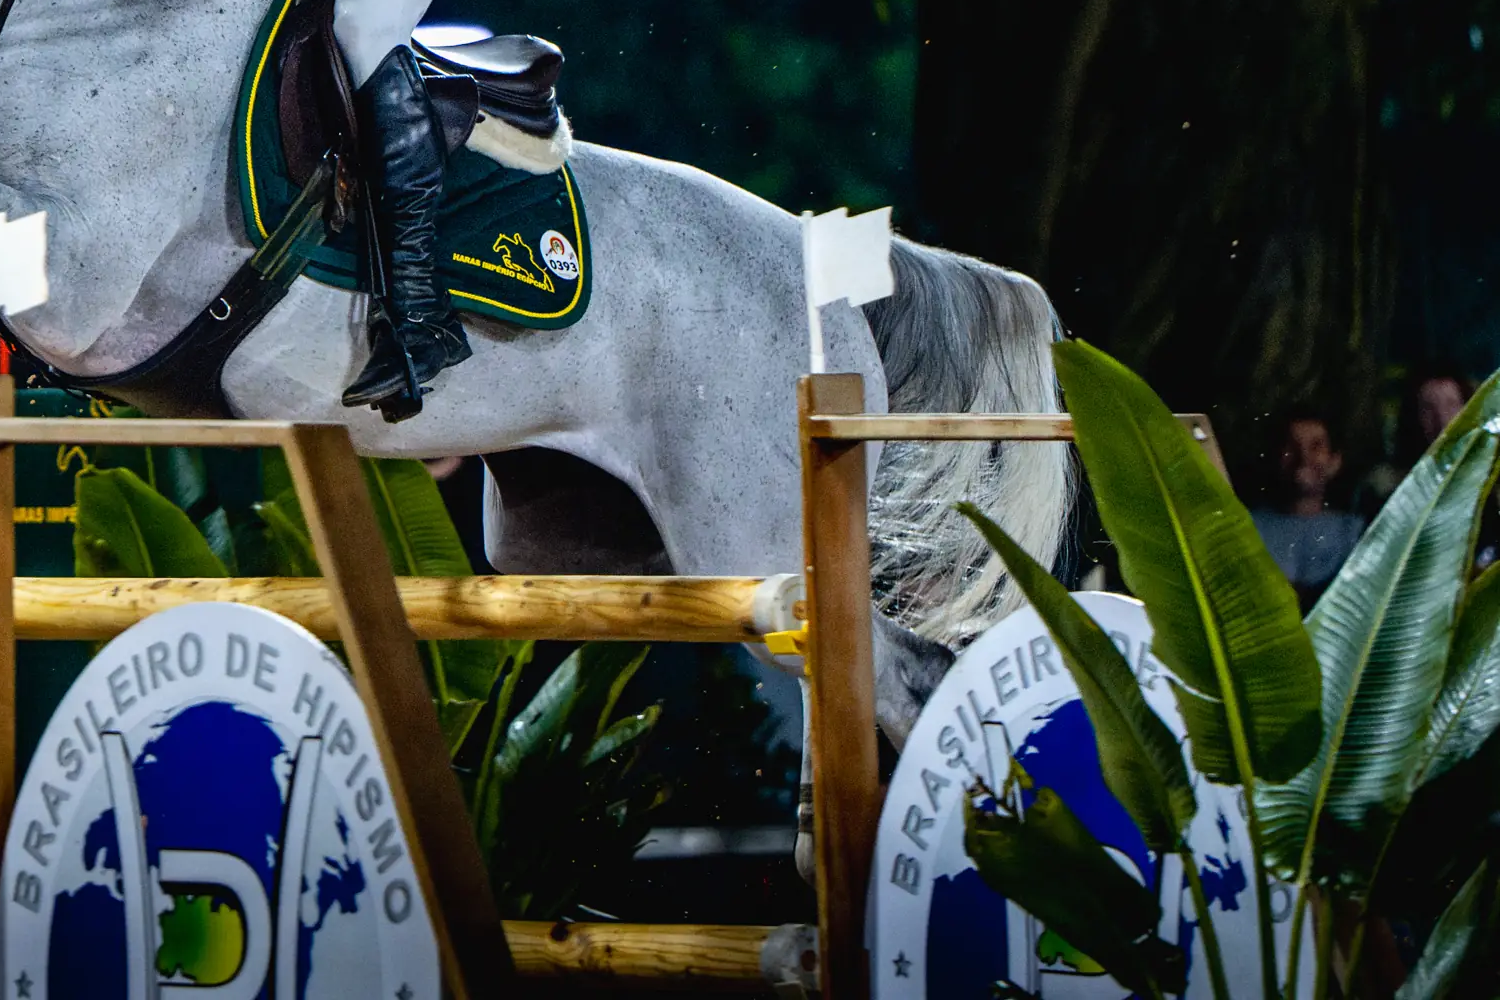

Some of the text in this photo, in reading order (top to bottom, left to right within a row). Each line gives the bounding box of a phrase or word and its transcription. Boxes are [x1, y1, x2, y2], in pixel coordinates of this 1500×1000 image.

[452, 252, 481, 267] HARAS
[549, 259, 578, 273] 0393
[12, 631, 412, 924] BRASILEIRO DE HIPISMO
[891, 635, 1060, 896] BRASILEIR
